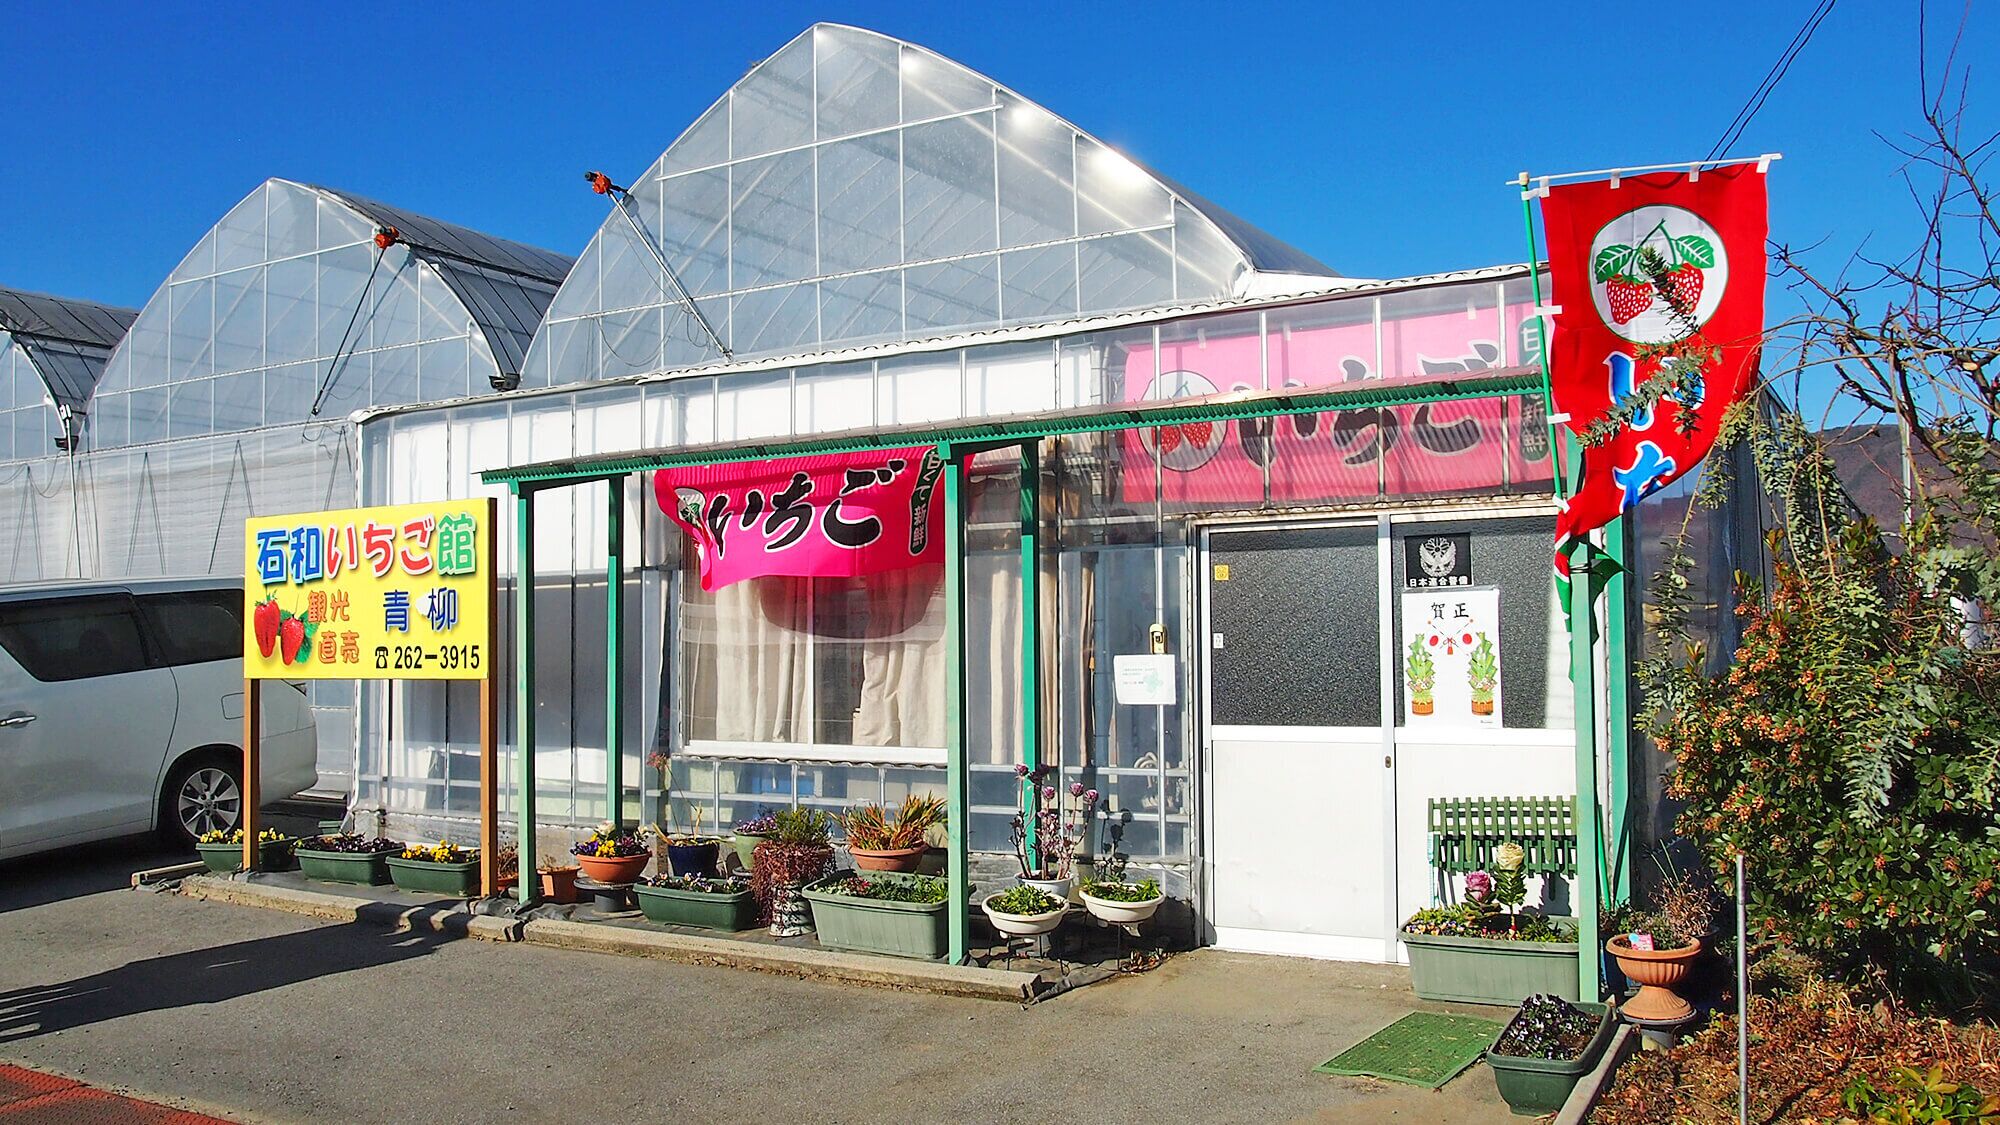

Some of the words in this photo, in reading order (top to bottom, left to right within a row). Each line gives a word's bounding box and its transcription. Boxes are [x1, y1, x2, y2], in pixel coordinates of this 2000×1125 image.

[707, 458, 907, 560] いちご
[256, 512, 477, 585] 石和いちご館
[307, 589, 350, 622] 観光
[383, 586, 457, 632] 青柳
[1431, 602, 1470, 620] 賀正
[317, 630, 360, 664] 直売
[393, 645, 480, 669] 262-3915
